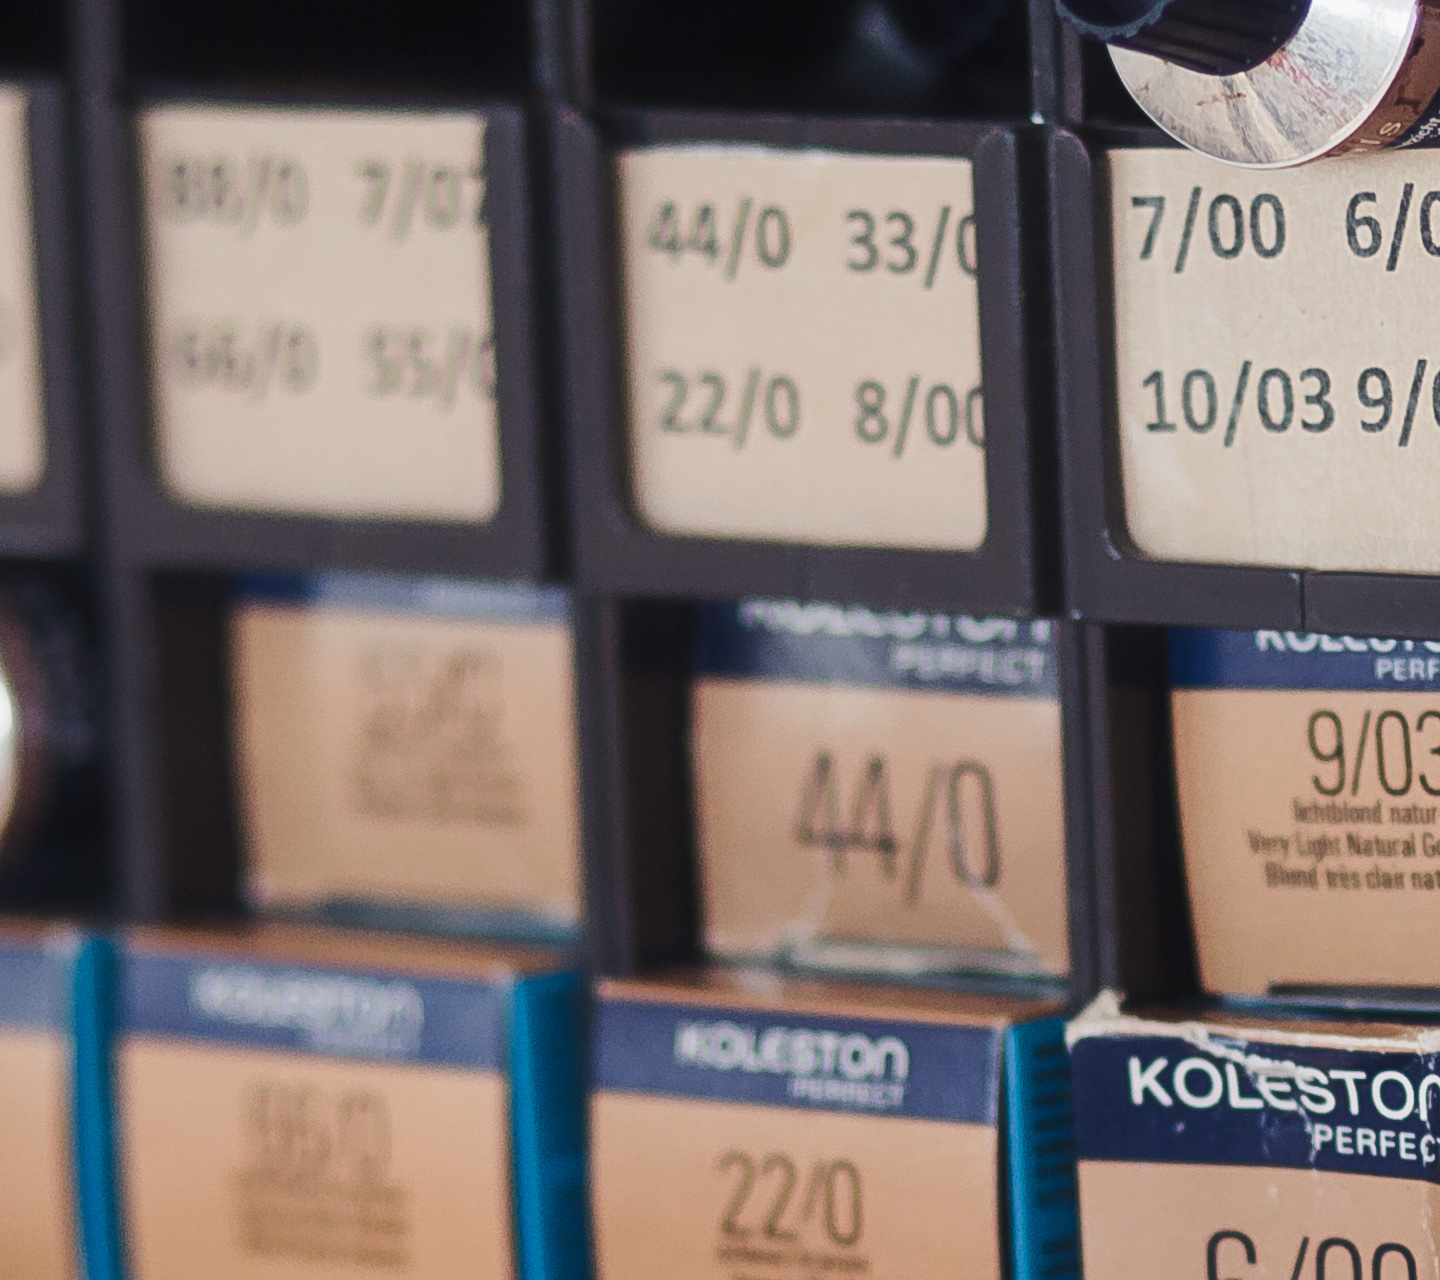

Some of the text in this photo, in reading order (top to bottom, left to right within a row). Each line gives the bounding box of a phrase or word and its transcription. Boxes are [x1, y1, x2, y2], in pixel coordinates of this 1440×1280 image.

[647, 199, 980, 289] 44/0 33/0
[1131, 186, 1288, 274] 7/00
[658, 367, 800, 453] 22/0
[1142, 361, 1336, 447] 10/03
[791, 748, 1002, 908] 44/0
[674, 1020, 911, 1082] KOLESTON
[717, 1147, 865, 1248] 22/0
